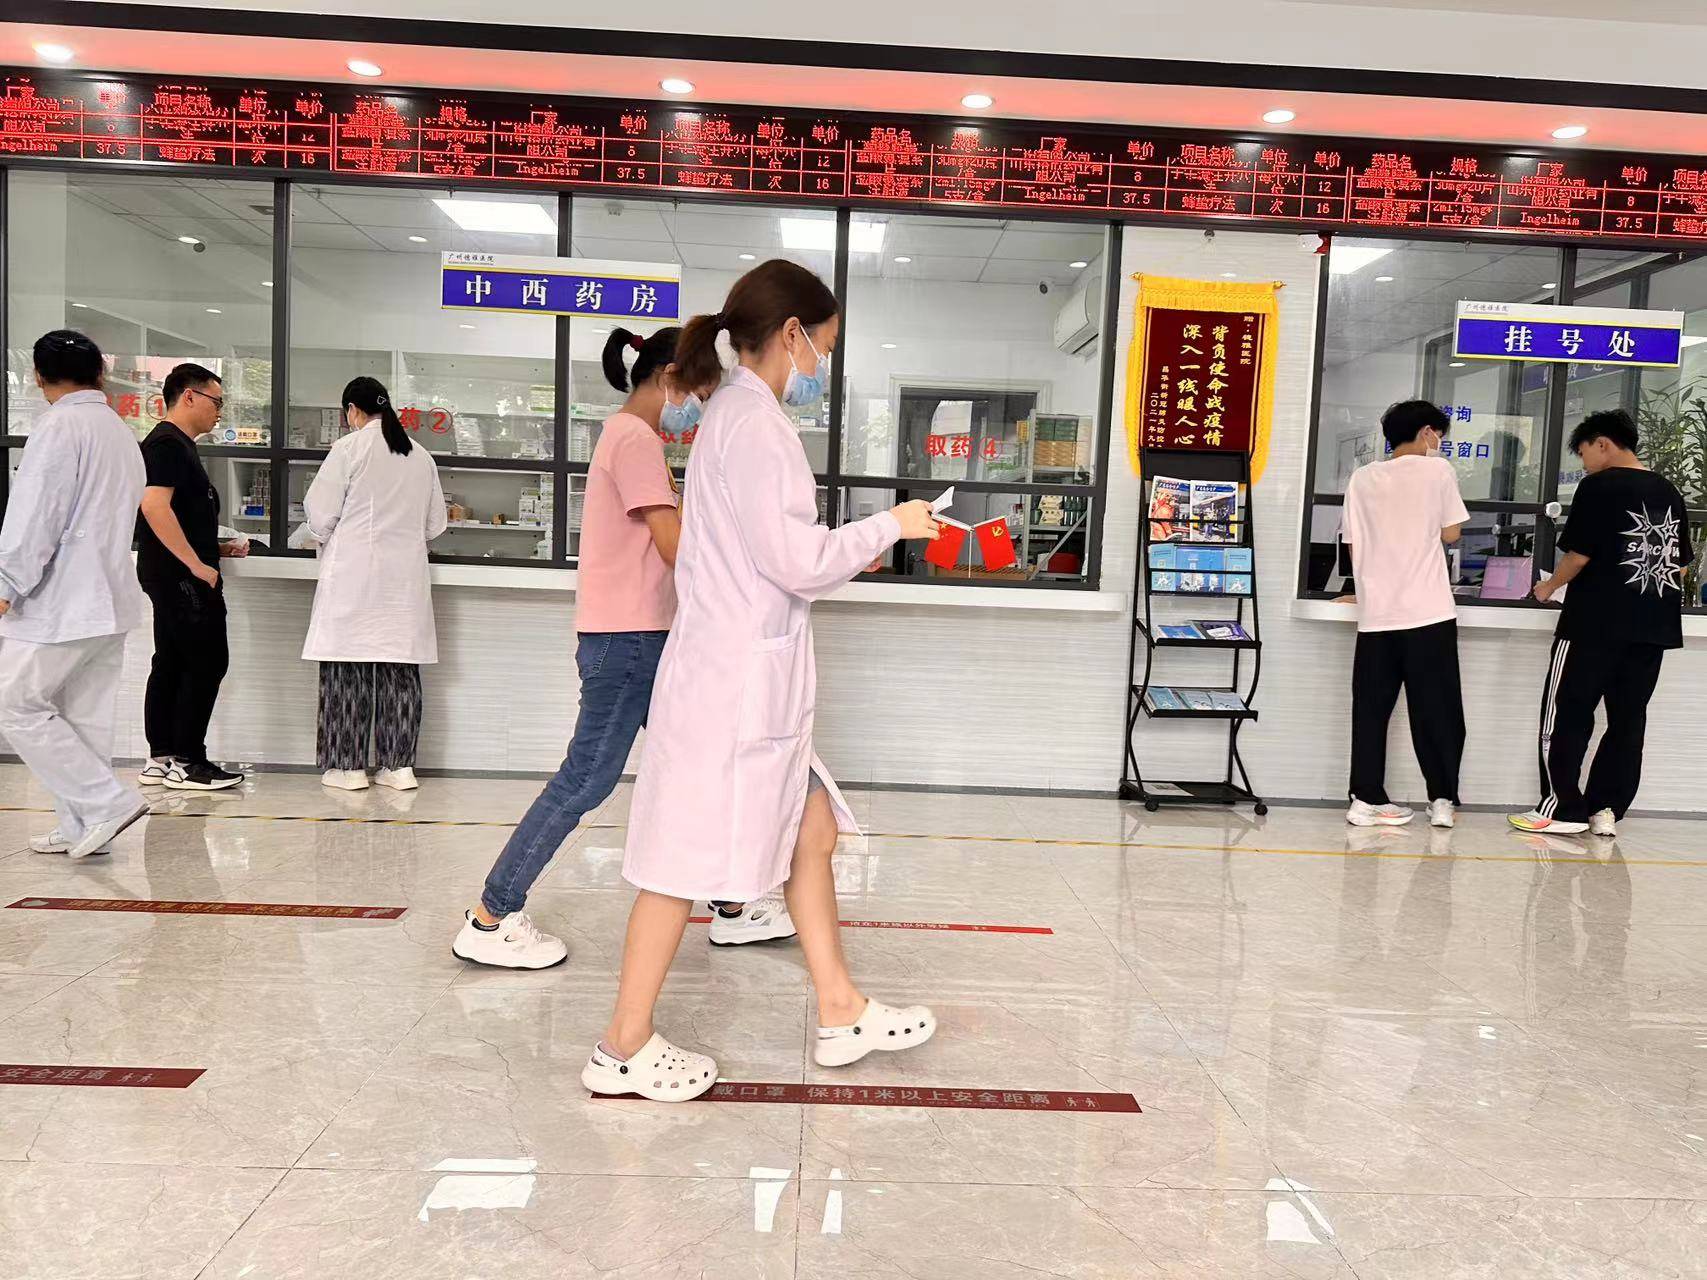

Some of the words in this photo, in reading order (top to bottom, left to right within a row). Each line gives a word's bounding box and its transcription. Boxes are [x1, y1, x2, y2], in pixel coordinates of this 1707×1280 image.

[295, 98, 324, 114] 单价
[620, 114, 648, 130] 单价
[757, 122, 784, 139] 单位
[812, 124, 840, 141] 单价
[870, 127, 912, 143] 药品名
[1040, 137, 1068, 150] 厂家
[1127, 141, 1155, 157] 单价
[251, 150, 267, 164] 次
[301, 152, 316, 164] 16
[1181, 144, 1235, 161] 项目名称
[1260, 148, 1288, 164] 单位
[1314, 151, 1341, 167] 单价
[1371, 153, 1412, 170] 药品名
[1451, 157, 1478, 173] 规格
[1536, 162, 1564, 176] 厂家
[617, 167, 646, 180] 37.5
[768, 174, 783, 189] 次
[1621, 165, 1648, 182] 单价
[816, 178, 831, 190] 16
[1318, 180, 1332, 192] 12
[1024, 187, 1086, 201] Ingelheim
[1122, 192, 1151, 205] 37.5
[1627, 195, 1636, 207] 8
[1269, 198, 1284, 214] 次
[1316, 202, 1330, 215] 16
[1519, 211, 1580, 226] Ingelheim
[1616, 216, 1644, 229] 37.5
[466, 274, 658, 313] 中西药房
[1504, 325, 1636, 358] 挂号处
[1174, 323, 1204, 445] 深入一线暖人心
[1203, 324, 1229, 447] 背负使命战疫情
[807, 1086, 1050, 1104] 保持1米以上安全距离
